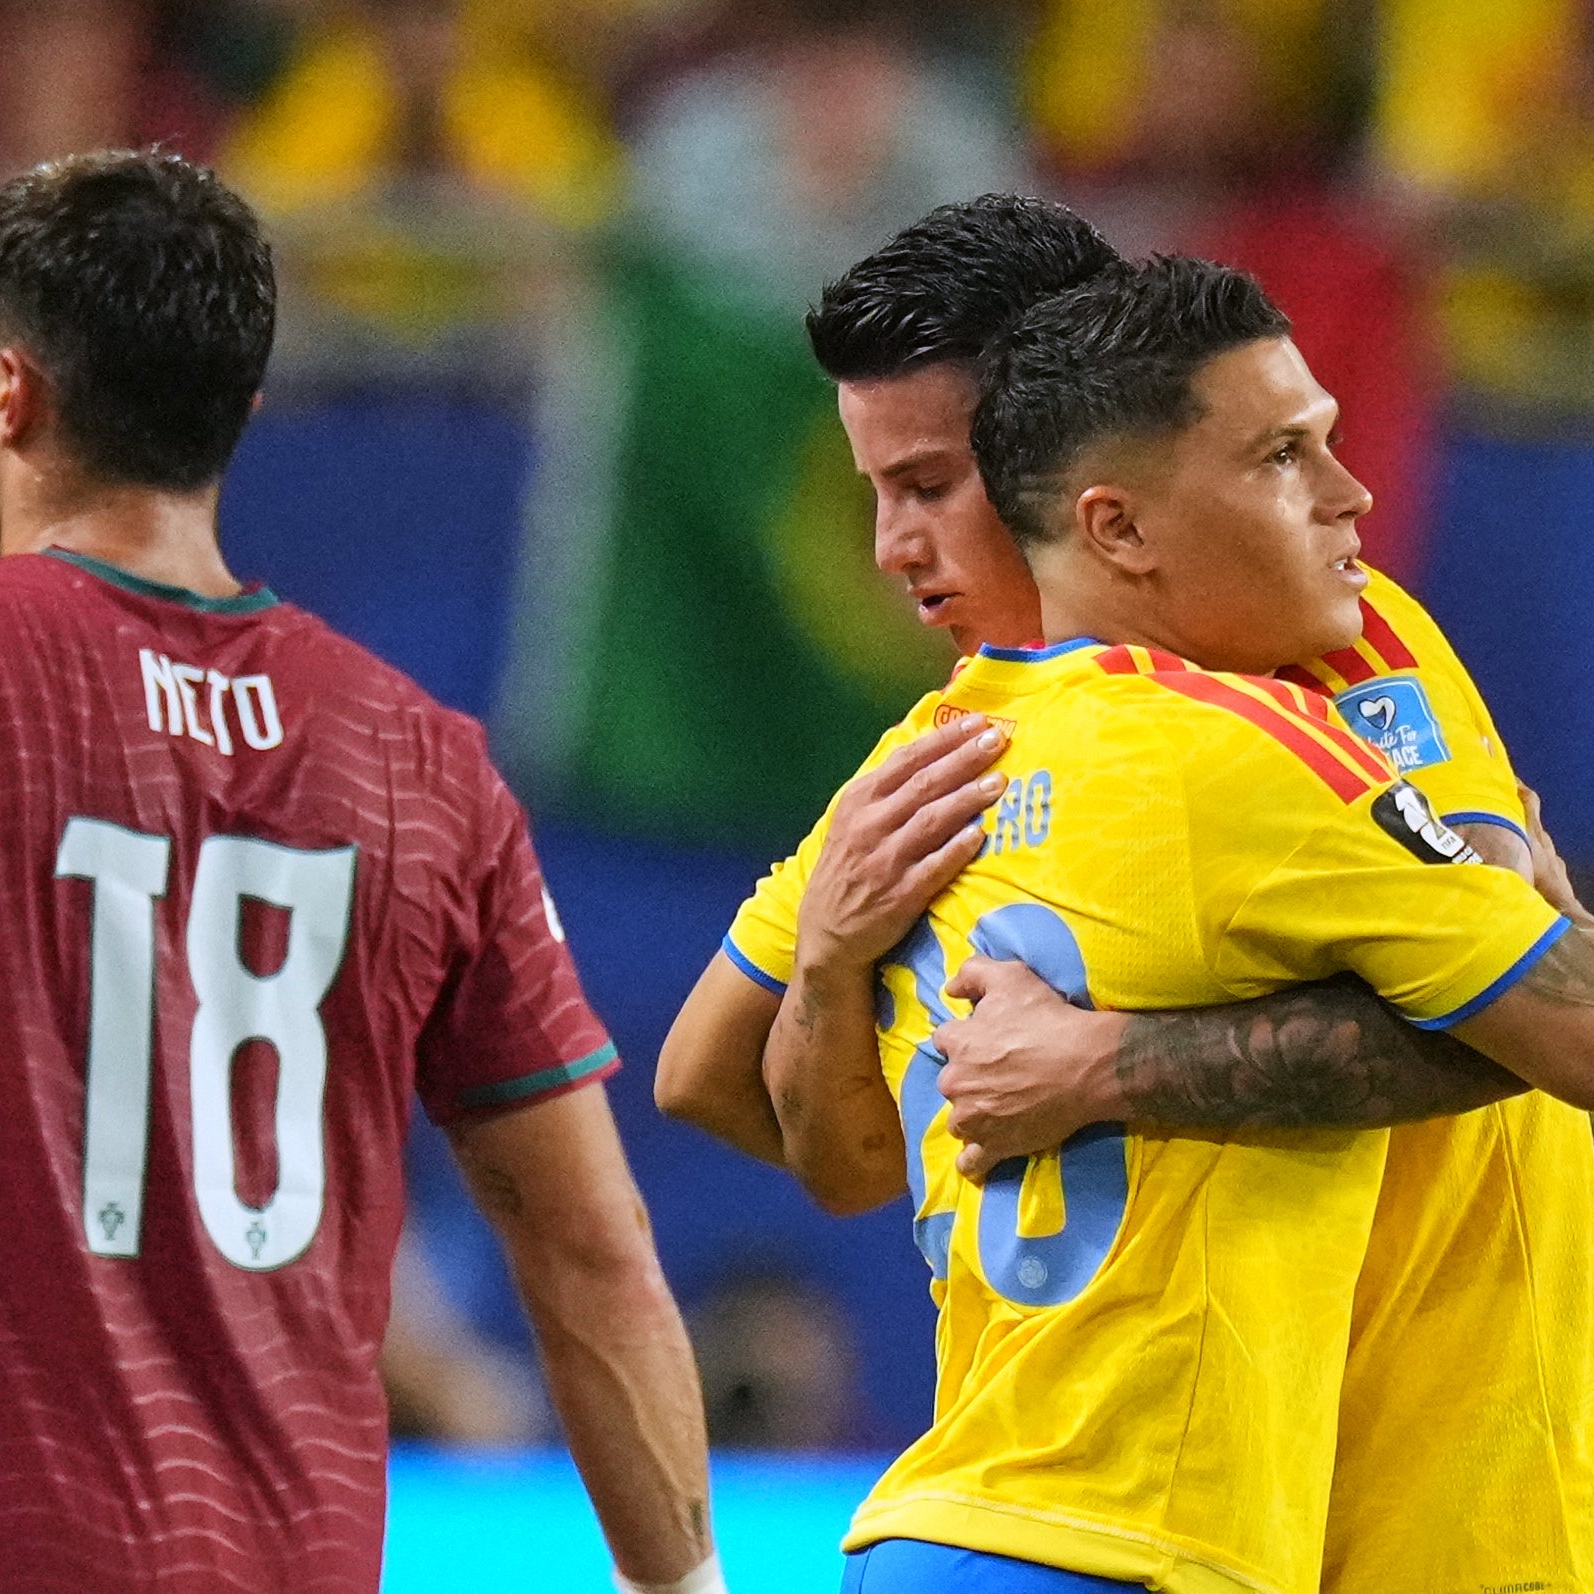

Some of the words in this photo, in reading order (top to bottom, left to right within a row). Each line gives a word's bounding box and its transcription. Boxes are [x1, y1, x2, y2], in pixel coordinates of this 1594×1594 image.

[139, 649, 284, 755] NETO
[1391, 745, 1423, 769] ACE
[53, 816, 358, 1271] 18
